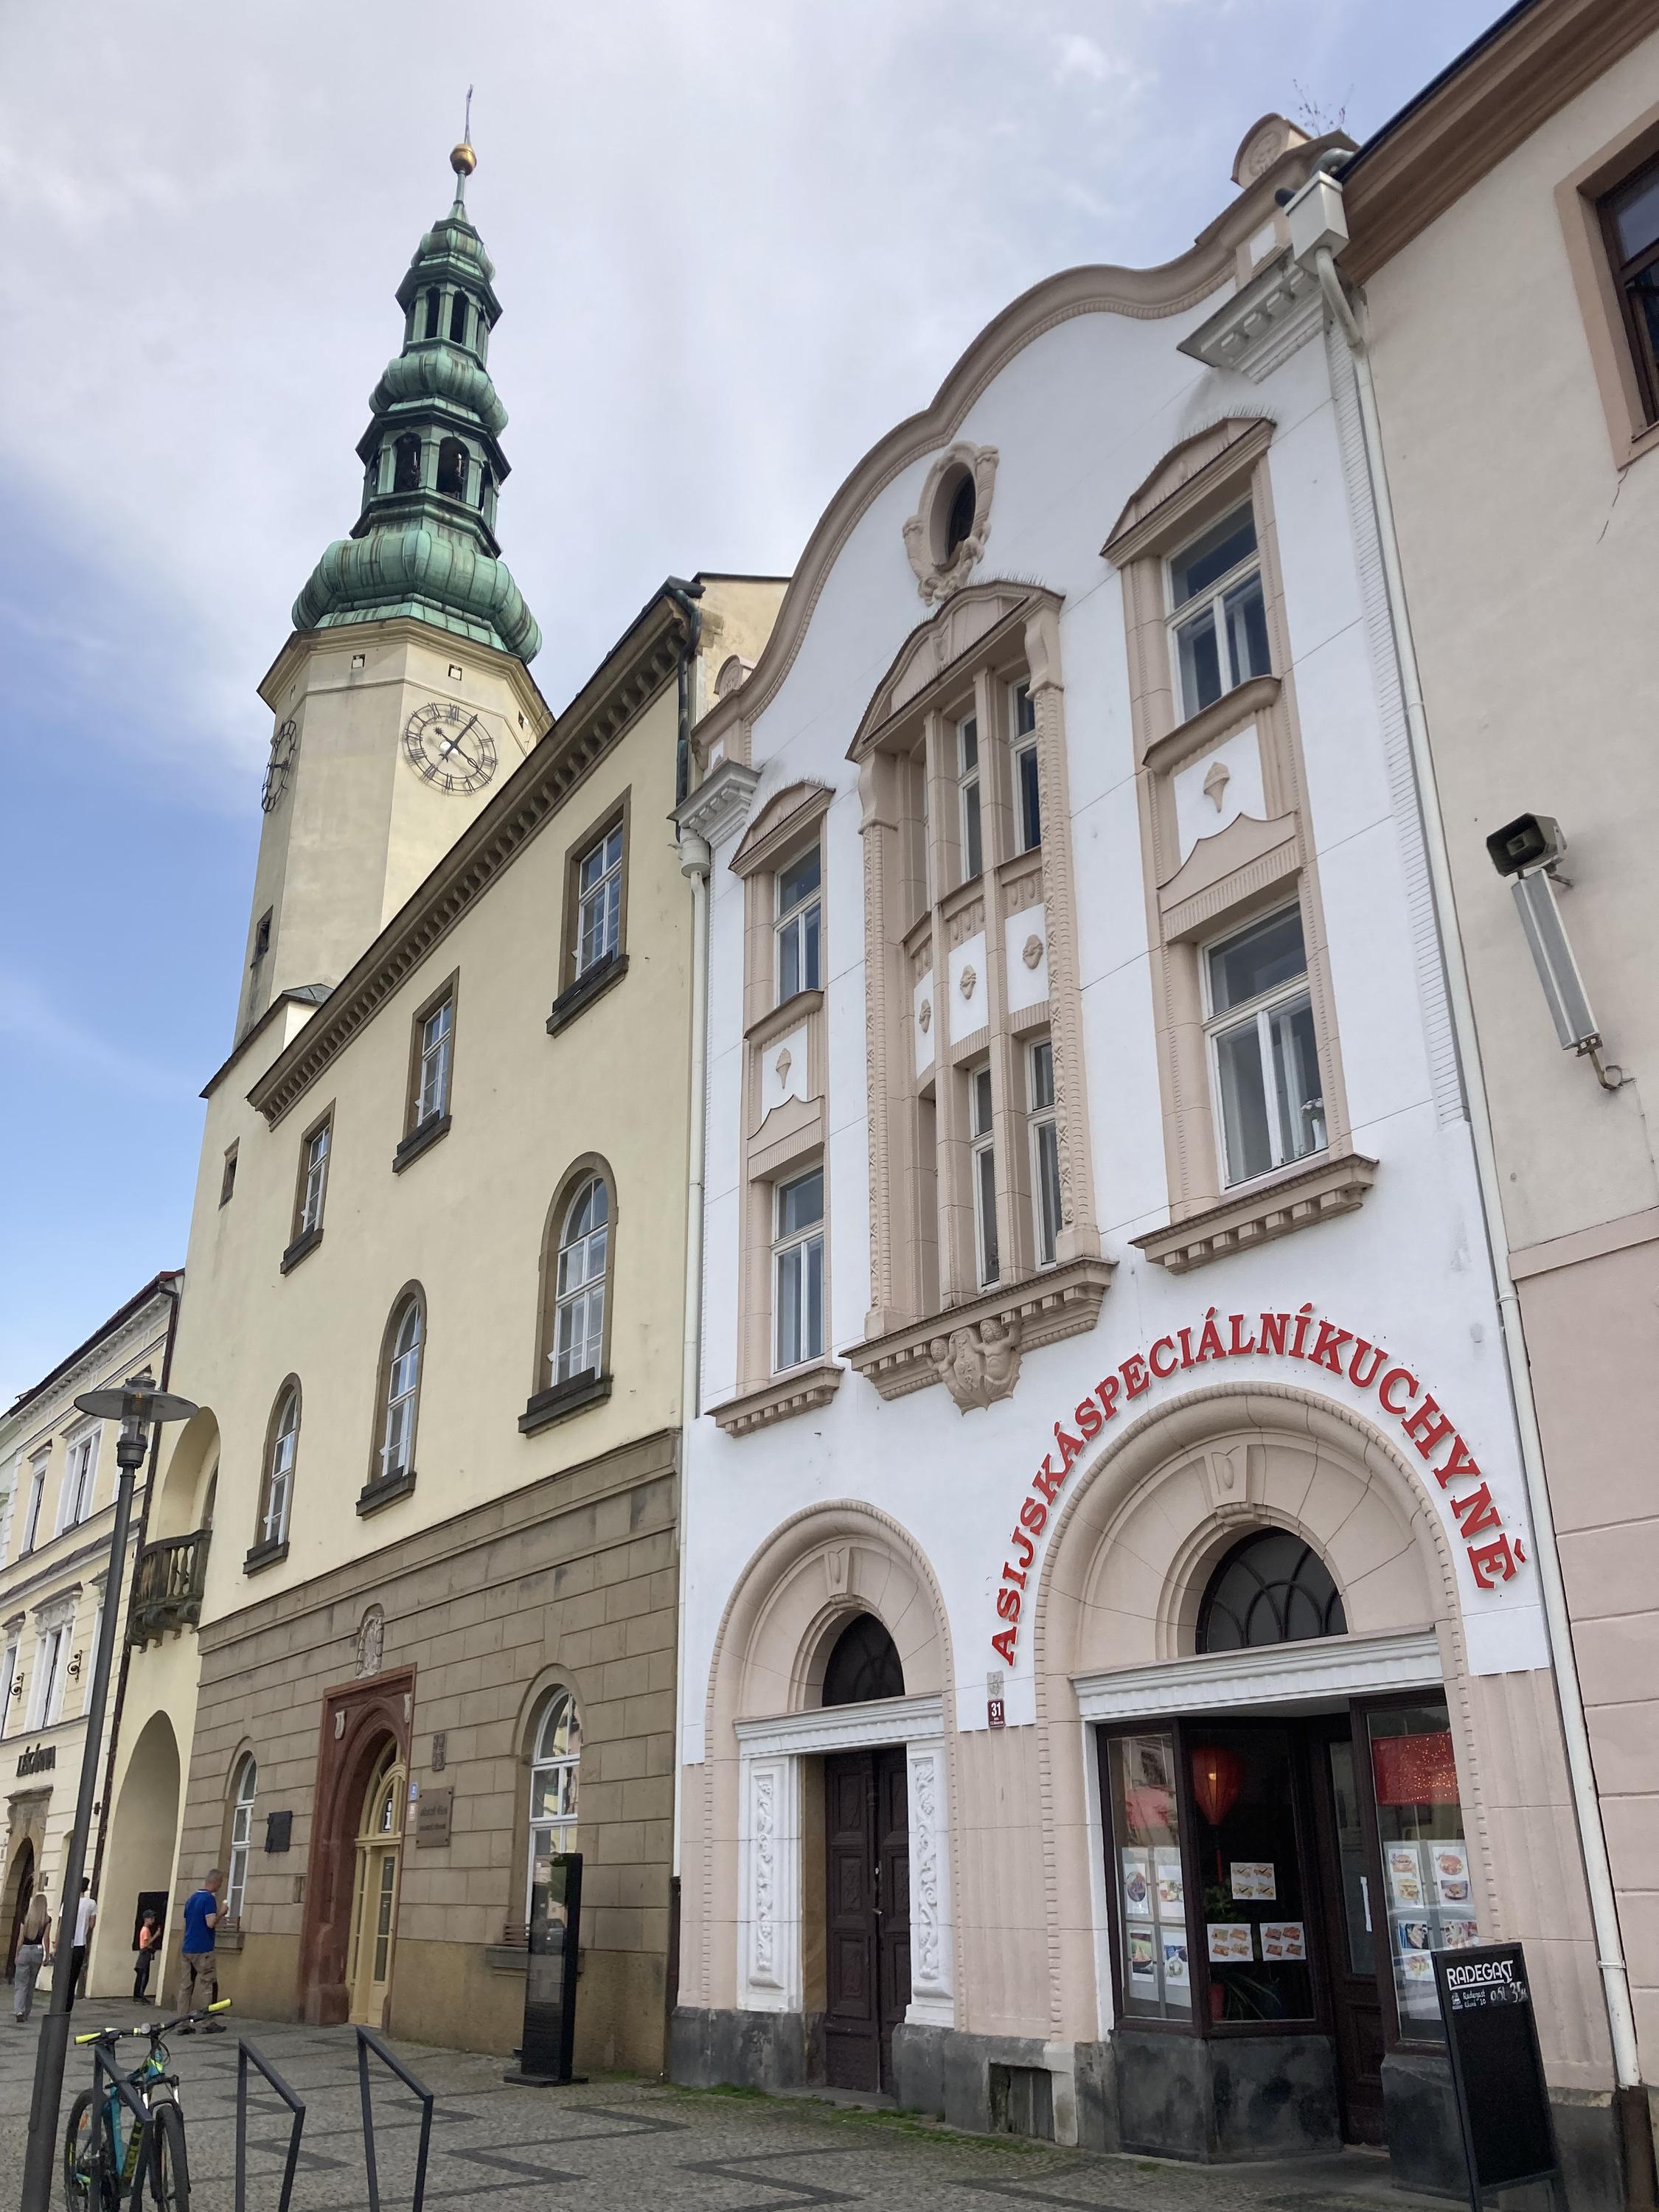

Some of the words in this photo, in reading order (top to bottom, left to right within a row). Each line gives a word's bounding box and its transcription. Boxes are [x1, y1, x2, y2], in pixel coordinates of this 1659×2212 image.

[992, 1422, 1084, 1666] ASIJSKÁ
[1074, 1303, 1312, 1440] SPECIÁLNÍ
[1308, 1320, 1526, 1590] KUCHYNĚ
[991, 1702, 1001, 1717] 31
[1446, 1960, 1514, 1990] RADEGAST
